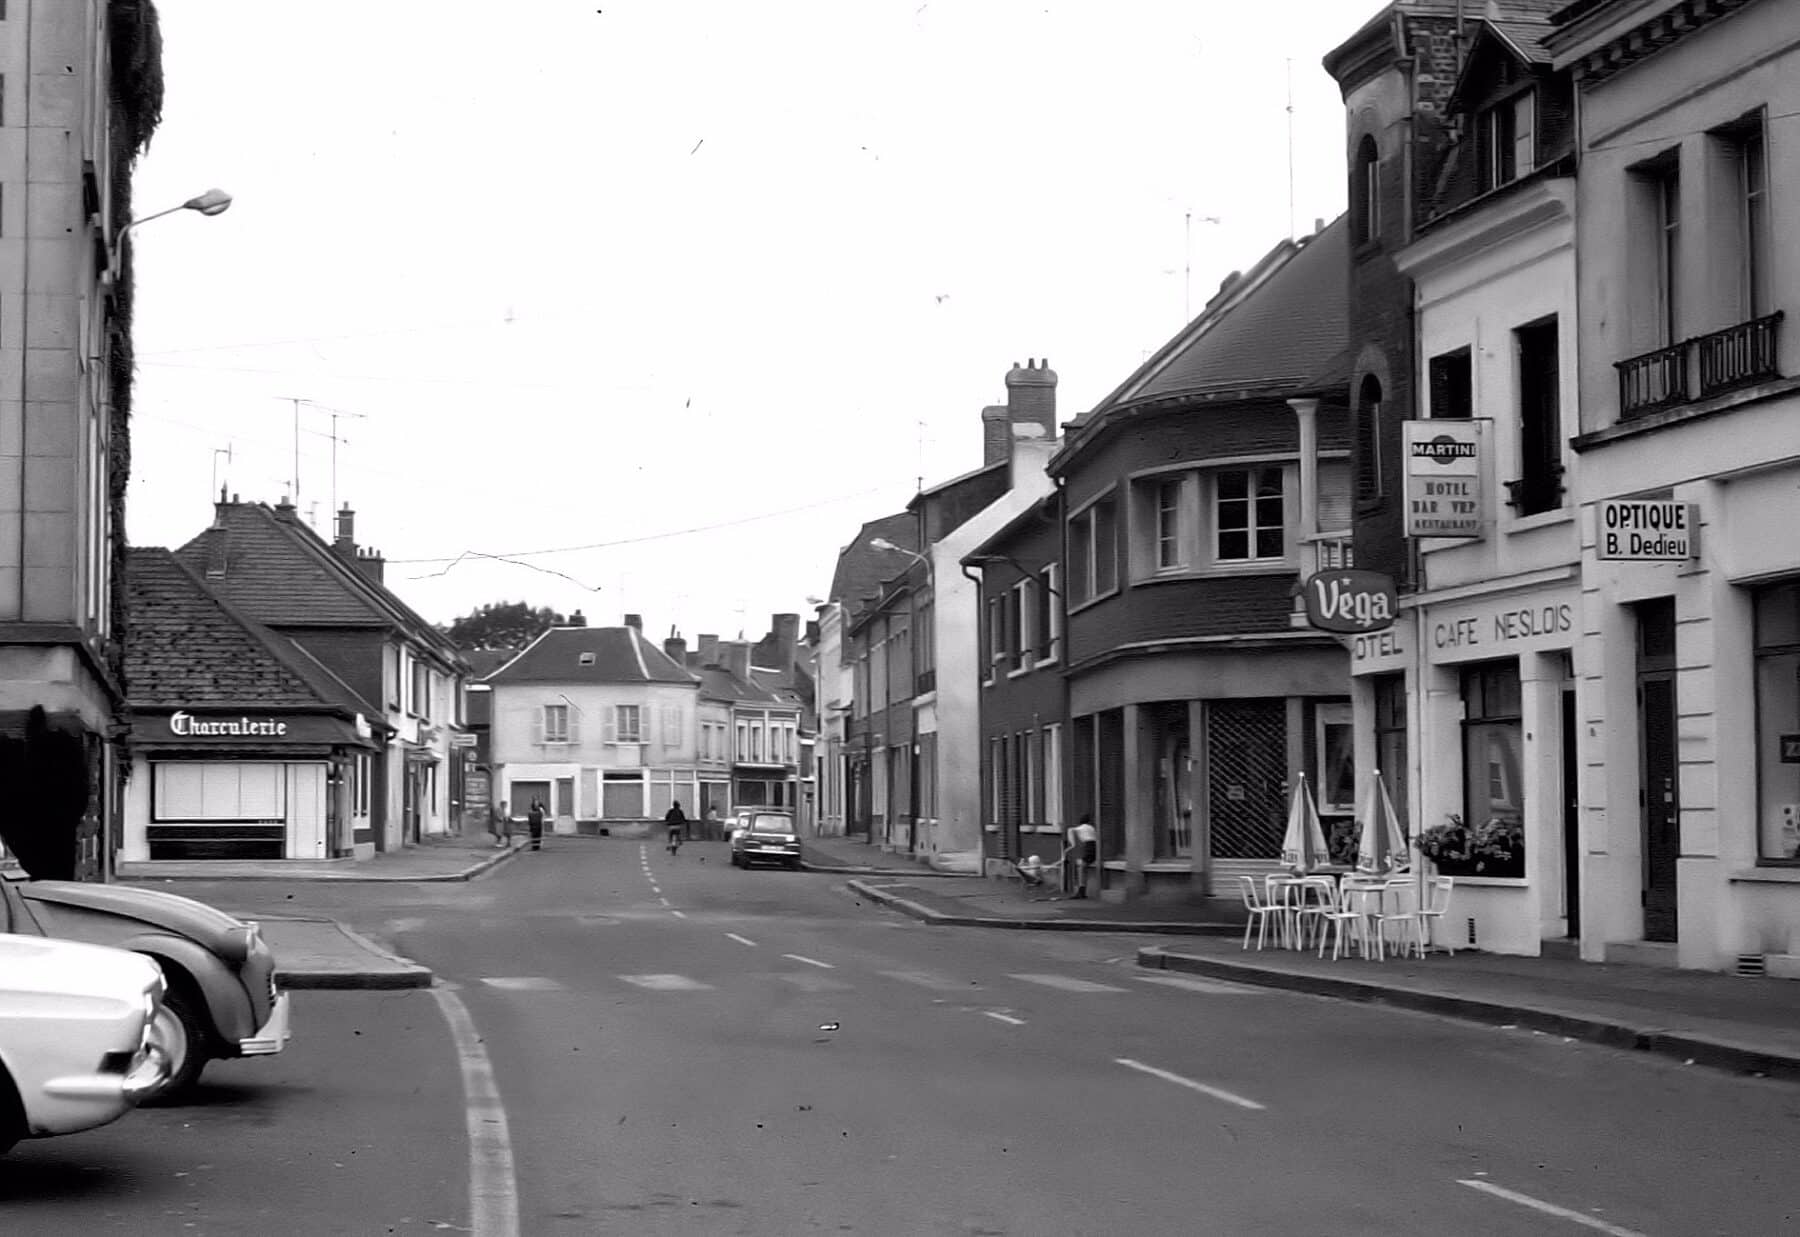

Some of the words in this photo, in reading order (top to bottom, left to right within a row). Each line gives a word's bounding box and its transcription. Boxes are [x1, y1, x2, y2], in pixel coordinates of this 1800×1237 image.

[1412, 443, 1476, 456] MARTINI
[1426, 482, 1469, 496] HOTEL
[1412, 501, 1438, 514] BAR
[1606, 504, 1685, 530] OPTIQUE
[1607, 533, 1622, 555] B.
[1630, 533, 1686, 555] Dedieu
[1435, 618, 1479, 649] CAFE
[1494, 604, 1572, 641] NESLOIS
[1354, 631, 1403, 660] OTEL
[170, 710, 287, 736] Charcuterie
